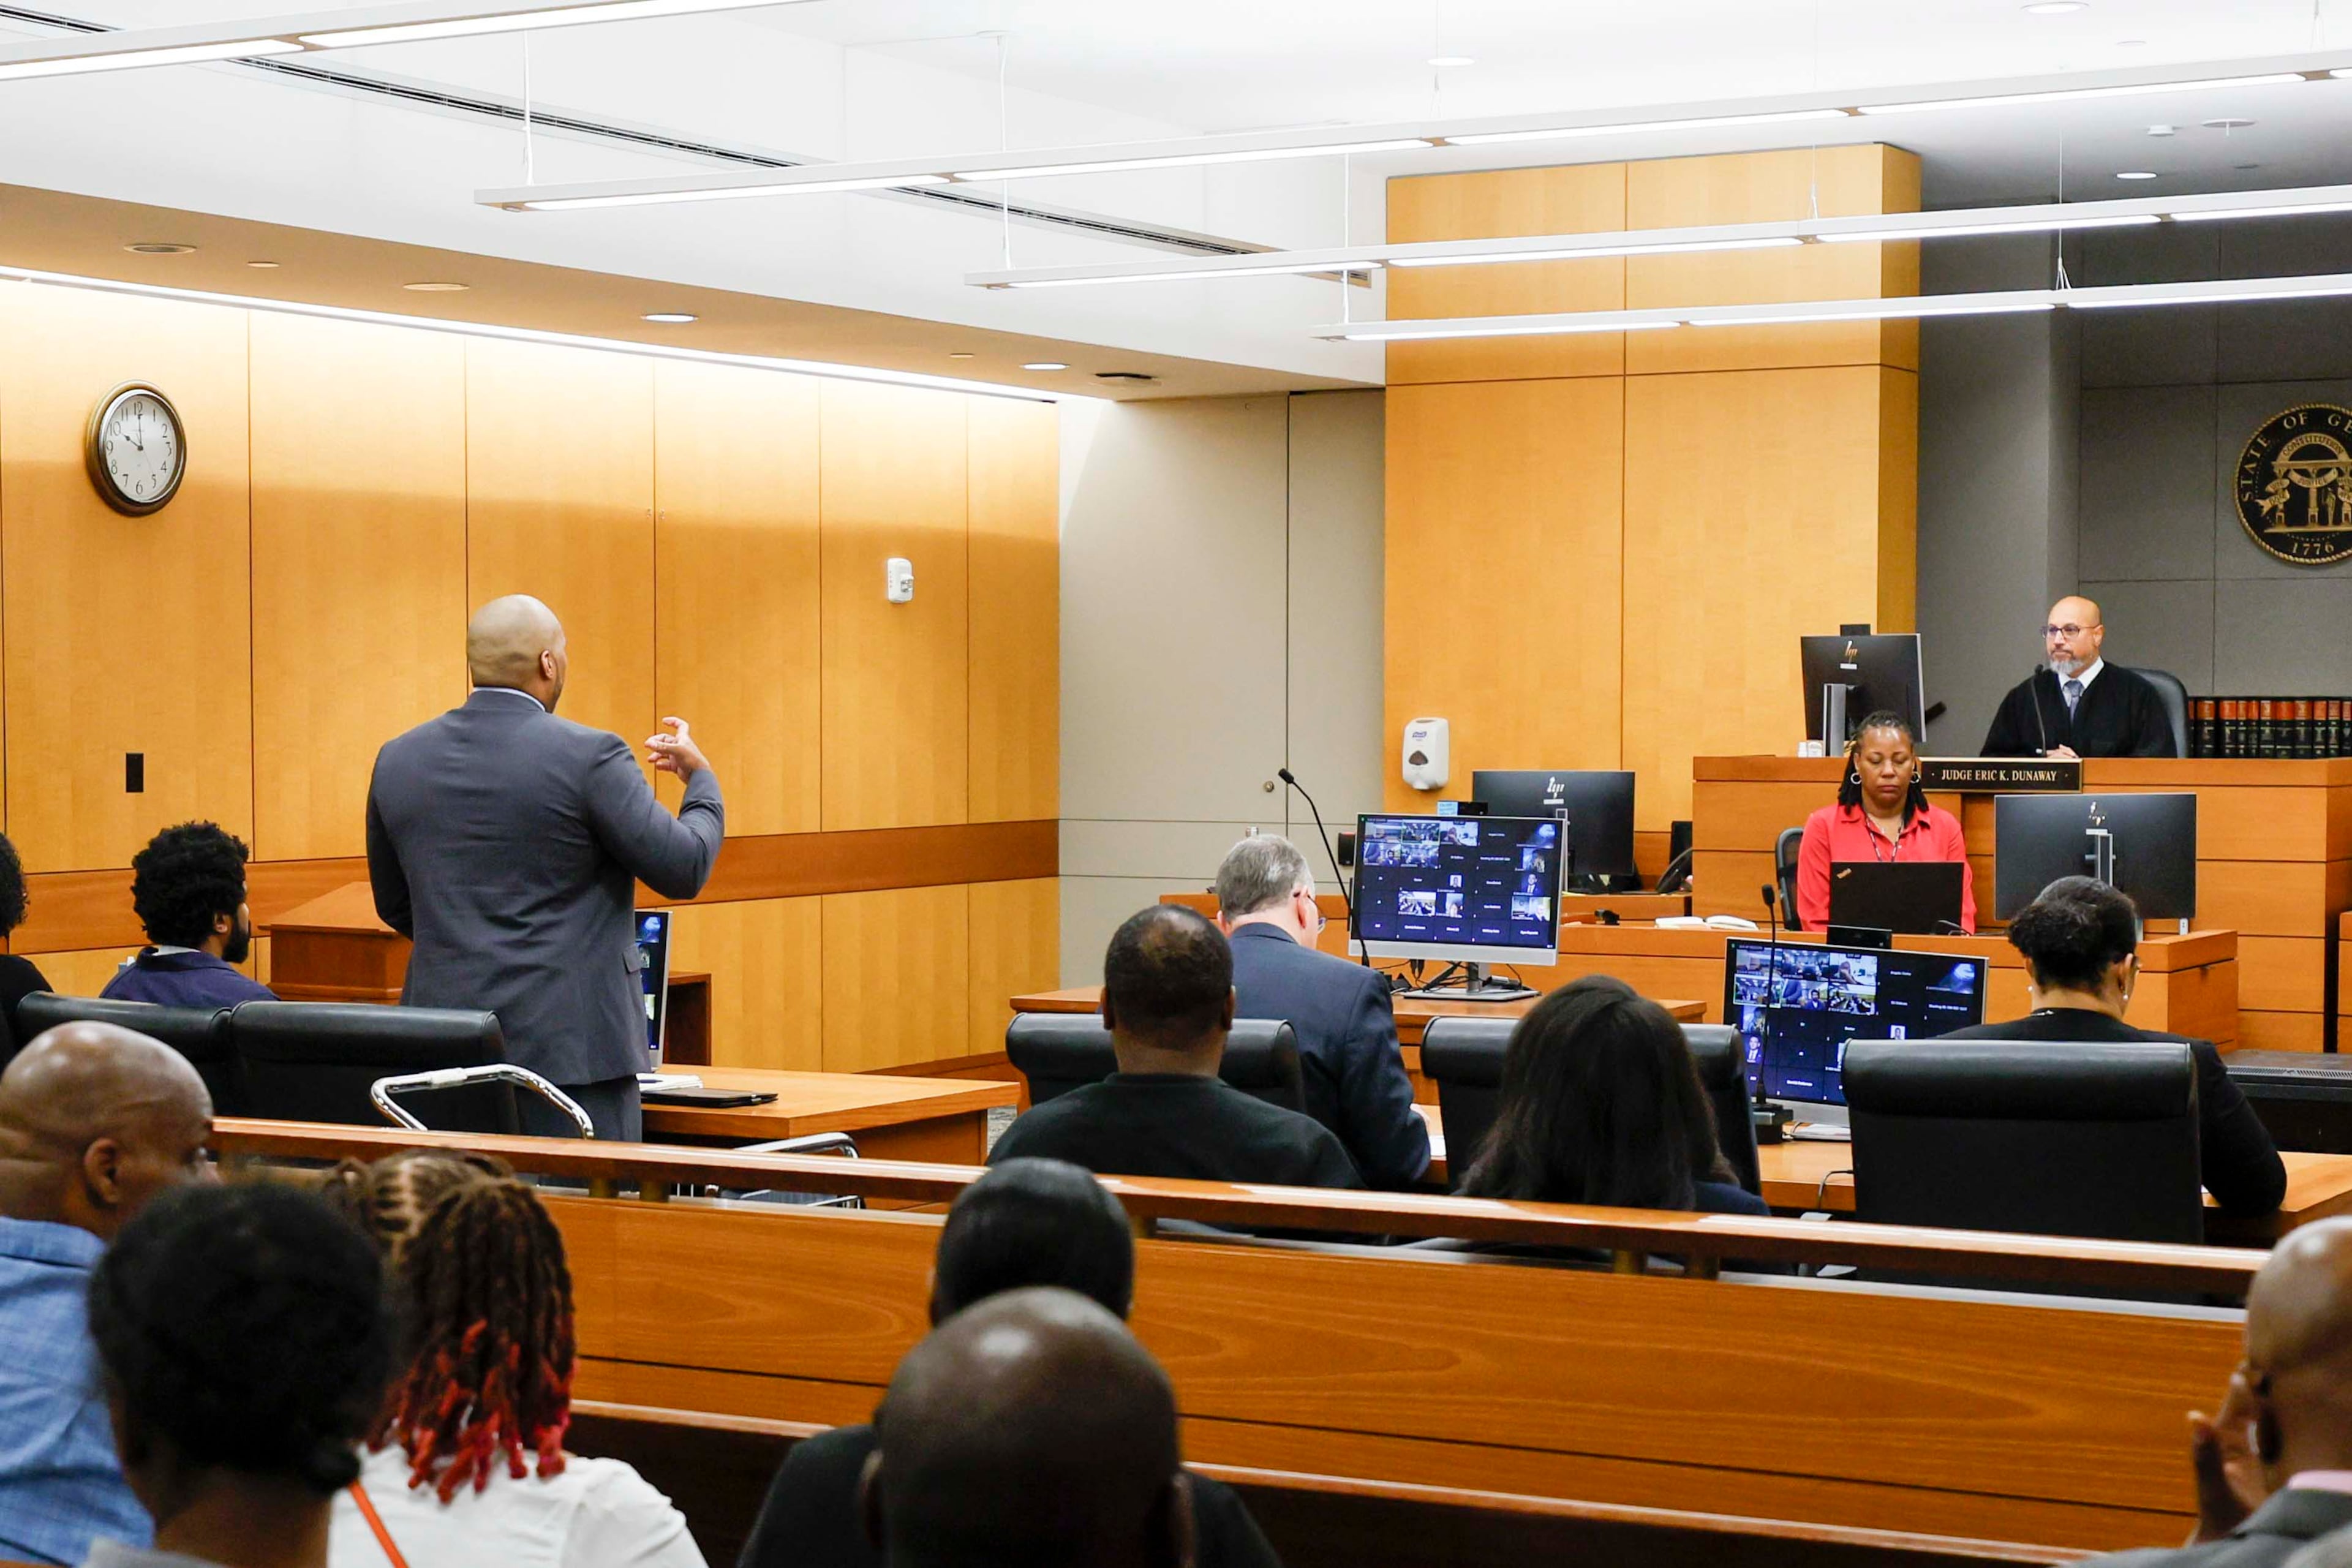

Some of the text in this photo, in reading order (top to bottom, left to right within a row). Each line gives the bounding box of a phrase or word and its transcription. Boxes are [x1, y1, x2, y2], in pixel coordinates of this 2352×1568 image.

[121, 407, 129, 421] 11
[134, 401, 143, 416] 12
[153, 409, 156, 422] 1
[109, 421, 121, 437] 10
[162, 423, 168, 439] 2
[106, 440, 113, 456] 9
[165, 442, 172, 456] 3
[2241, 436, 2270, 502] STATE
[2283, 412, 2308, 429] OF
[110, 459, 118, 475] 8
[160, 461, 167, 473] 4
[122, 473, 129, 488] 7
[136, 480, 143, 496] 6
[151, 474, 157, 489] 5
[2292, 543, 2334, 556] 1776
[1941, 769, 2057, 782] JUDGE ERIC K. DUNAWAY
[1547, 776, 1565, 799] hp
